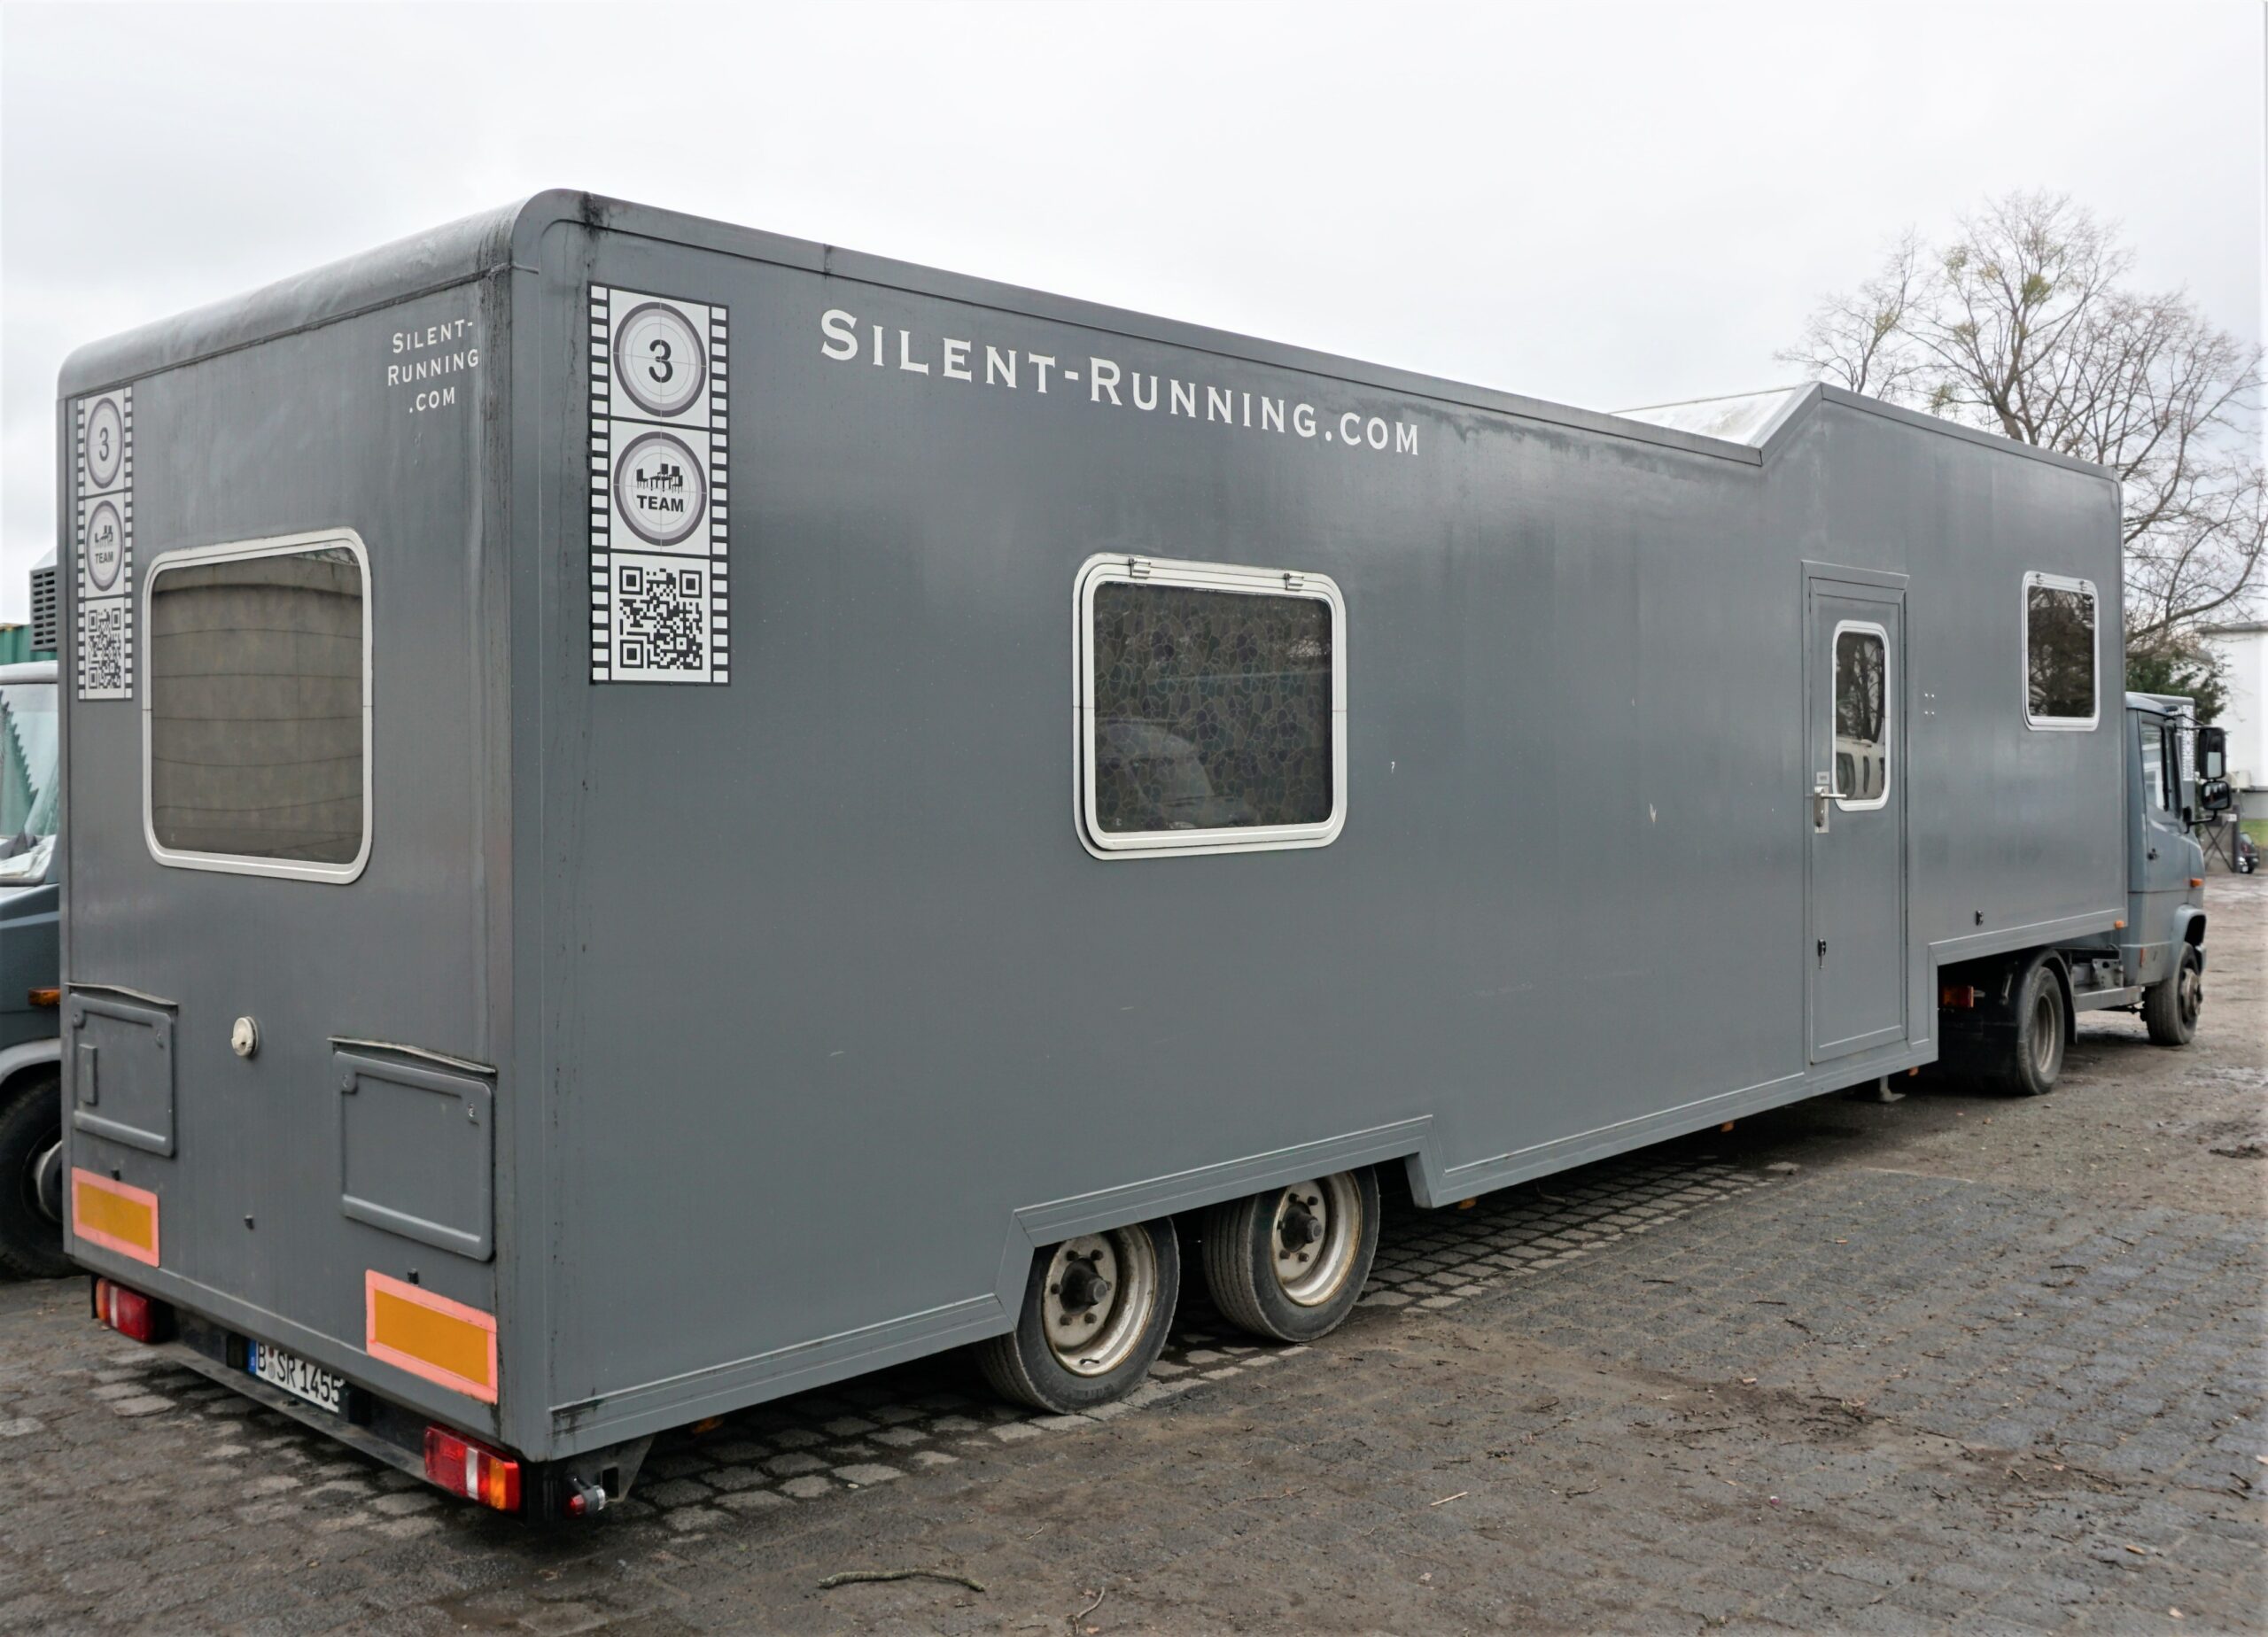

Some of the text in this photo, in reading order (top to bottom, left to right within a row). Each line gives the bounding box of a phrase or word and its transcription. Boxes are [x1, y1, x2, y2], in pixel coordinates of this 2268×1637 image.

[387, 349, 479, 386] RUNNING
[649, 338, 673, 384] 3
[98, 426, 110, 462] 3
[636, 494, 684, 513] TEAM
[95, 551, 114, 564] TEAM
[258, 1343, 341, 1407] B SR 1455
